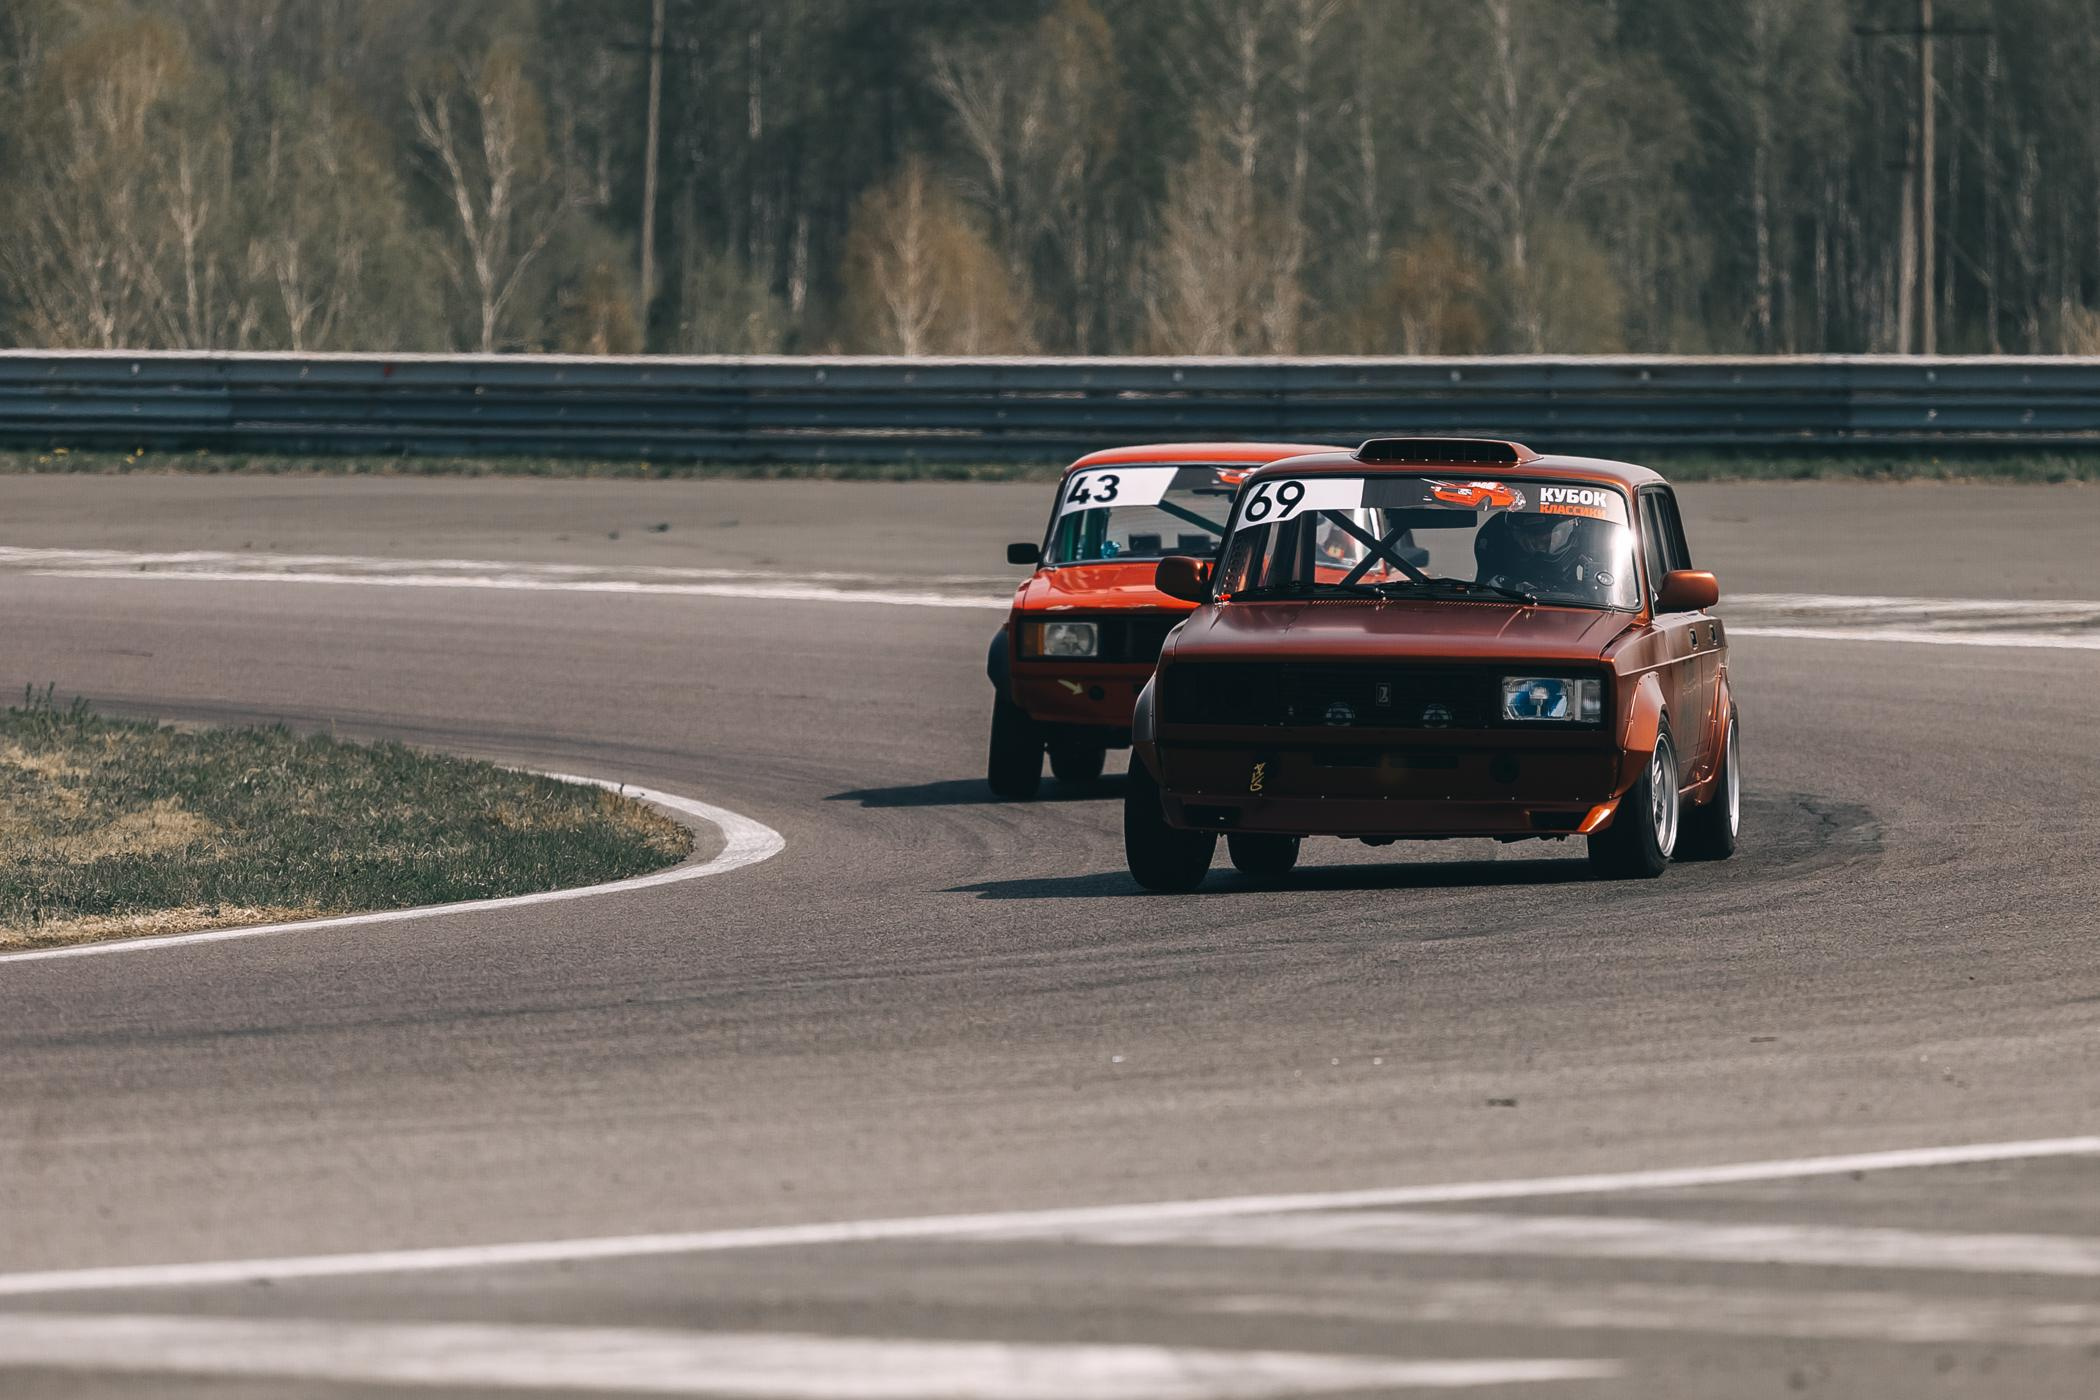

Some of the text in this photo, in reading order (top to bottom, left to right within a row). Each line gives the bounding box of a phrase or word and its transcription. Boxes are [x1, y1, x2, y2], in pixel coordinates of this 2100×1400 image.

[1066, 474, 1120, 505] 43
[1245, 480, 1306, 522] 69
[1540, 487, 1607, 508] КУБОК
[1540, 503, 1607, 518] КЛАССИКИ
